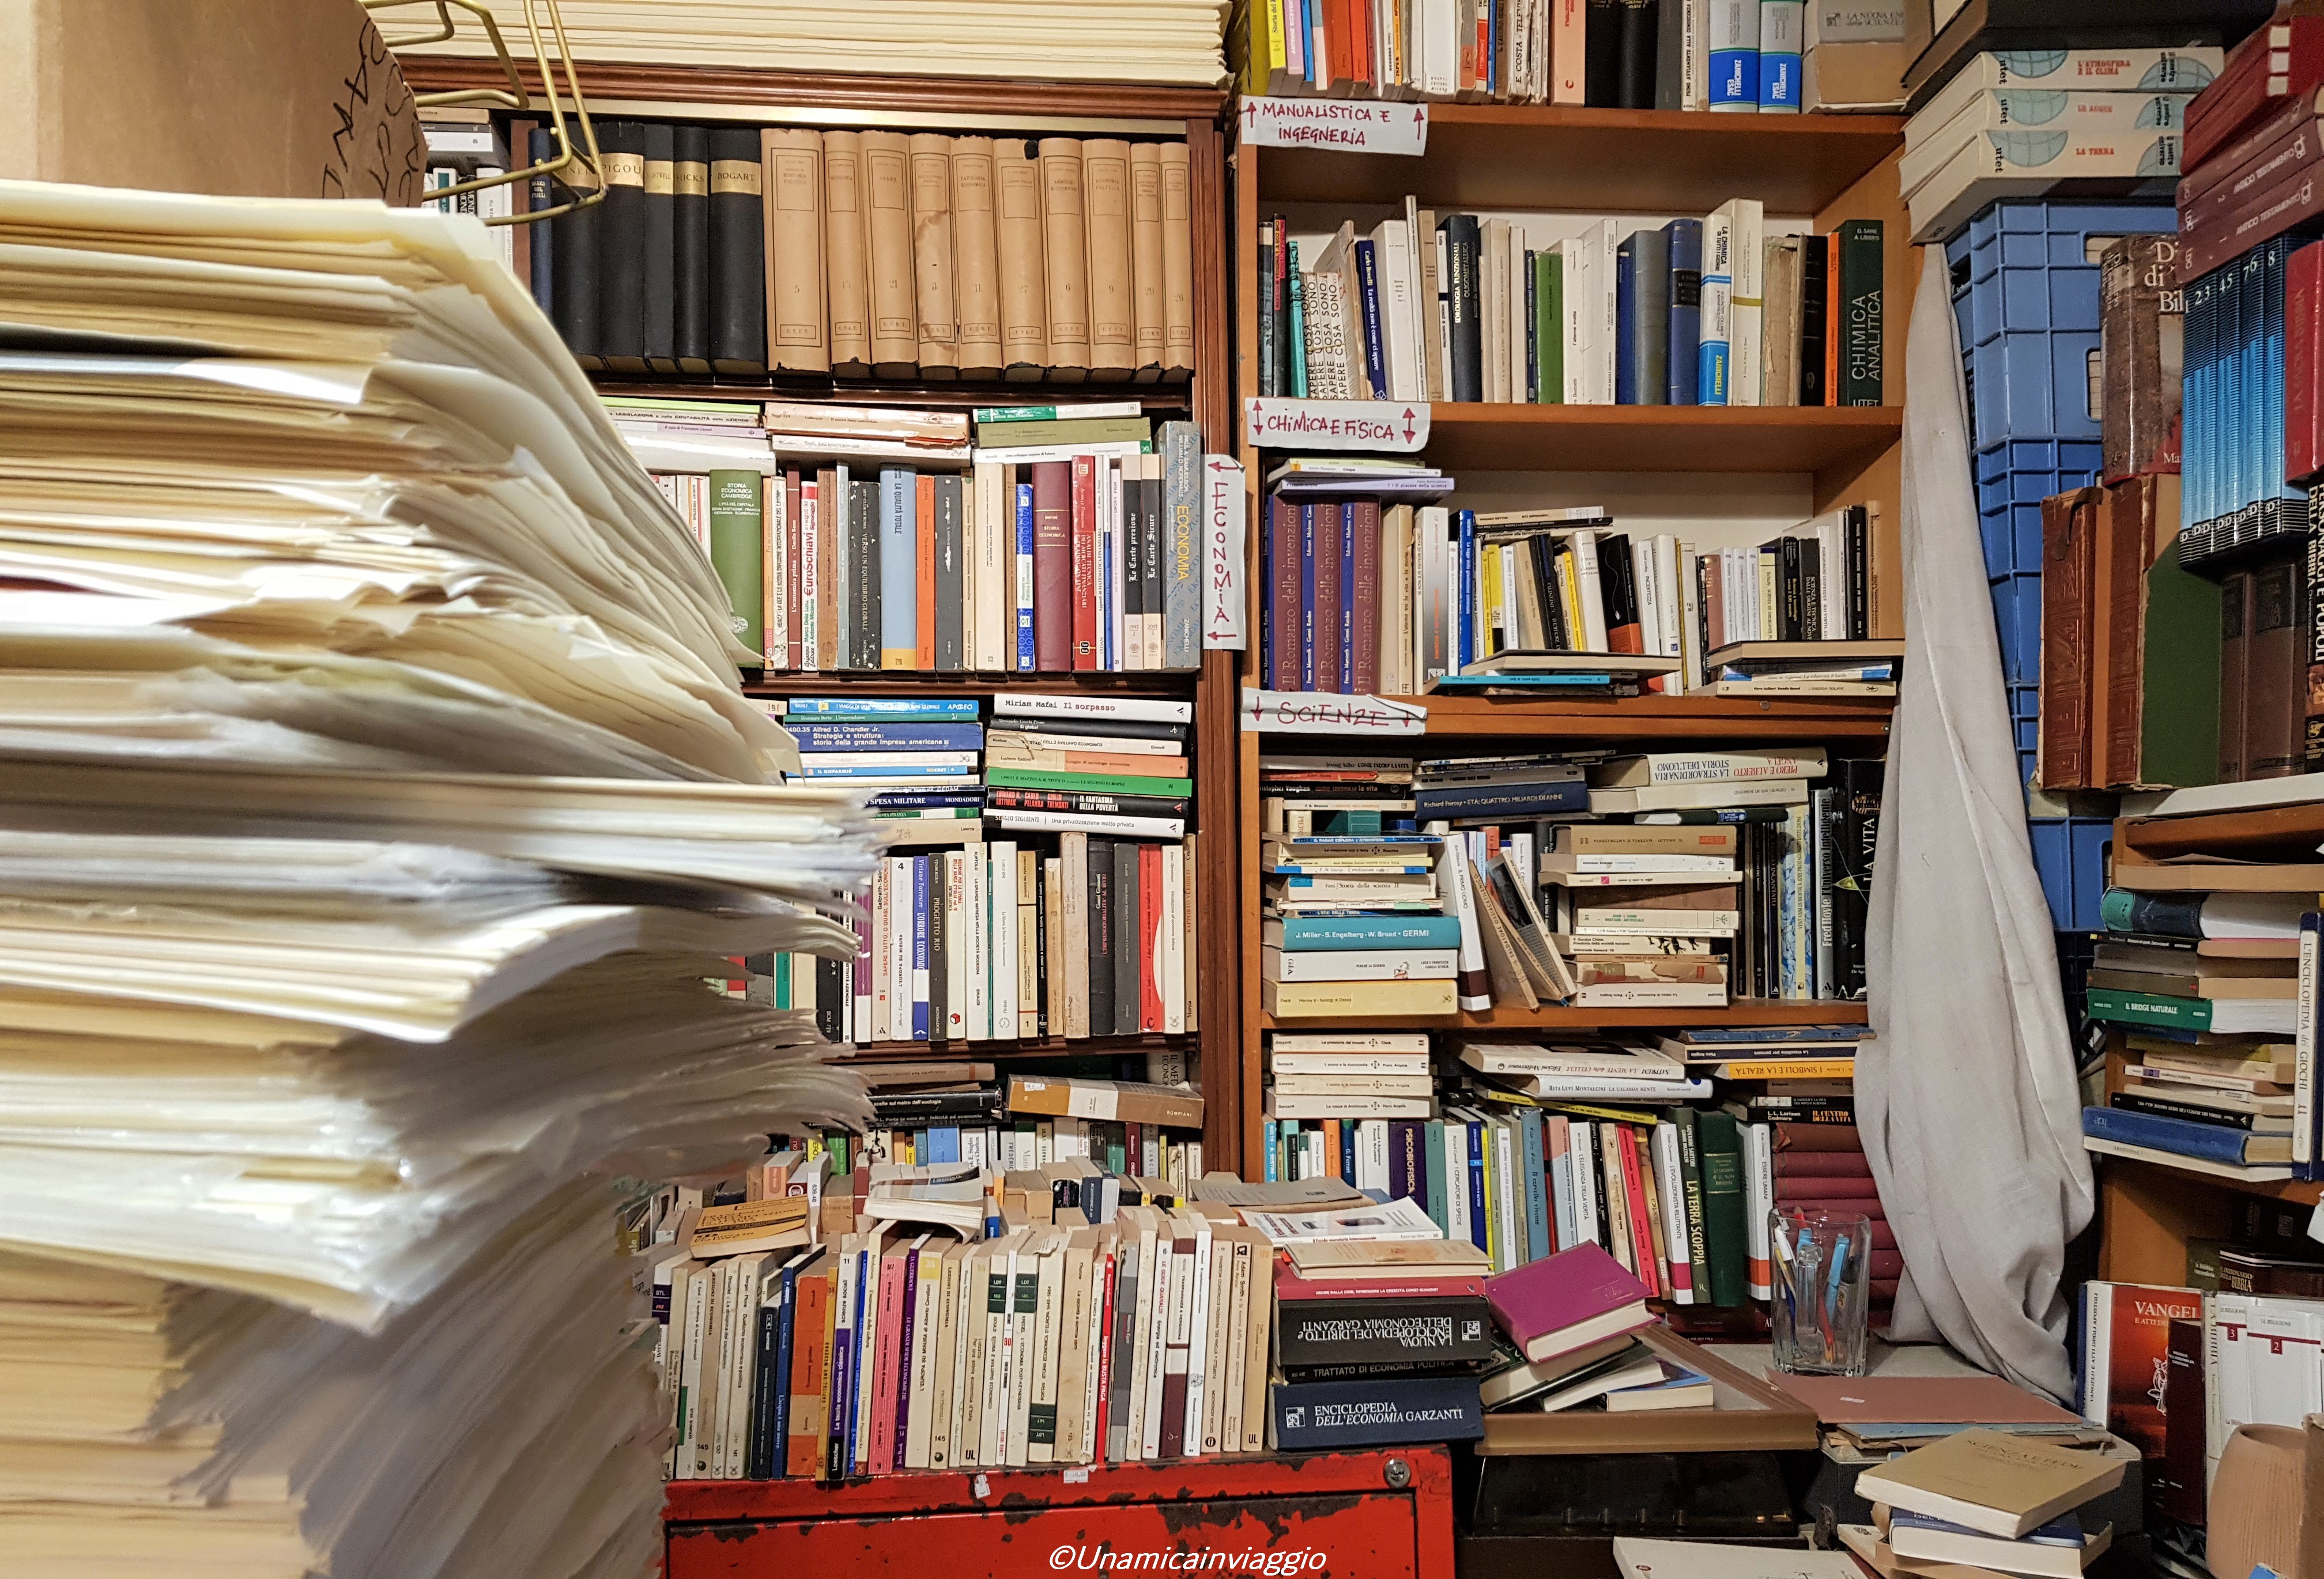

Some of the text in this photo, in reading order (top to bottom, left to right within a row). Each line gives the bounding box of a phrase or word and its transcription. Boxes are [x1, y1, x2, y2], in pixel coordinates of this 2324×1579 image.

[1998, 59, 2006, 85] utet
[1263, 103, 1391, 122] MANUALISTICA E
[1278, 122, 1365, 145] INGEGNERIA
[1995, 146, 2004, 173] utet
[676, 174, 704, 183] HICKS
[718, 172, 754, 182] BOGART
[1722, 226, 1727, 235] LA
[1852, 296, 1866, 380] CHIMICA
[1868, 290, 1881, 381] ANALITICA
[1268, 411, 1394, 441] CHIMICA E FISICA
[894, 491, 903, 512] QUALITÀ
[1177, 505, 1190, 580] ECONOMIA
[2307, 486, 2318, 588] DELLA BIBBIA
[862, 553, 867, 562] UN
[1212, 482, 1231, 624] ECONOMIA
[1282, 504, 1296, 685] Il Romanzo delle invenzioni
[1320, 504, 1334, 685] Il Romanzo delle invenzioni
[1358, 504, 1372, 685] Il Romanzo delle invenzioni
[1277, 701, 1390, 727] SCIENZE
[1657, 760, 1729, 771] STORIA DELL'UOMO
[1734, 765, 1798, 776] PIERO E ALBERTO
[1655, 770, 1718, 781] STRAORDINARIA
[1080, 802, 1118, 812] DELLA POVERTÀ
[2131, 1003, 2149, 1013] BRIDGE
[2151, 1004, 2178, 1015] NATURALE
[1736, 1067, 1764, 1076] REALTÀ
[1405, 1128, 1416, 1194] PSICOBIOFISICA
[1687, 1181, 1705, 1265] LA TERRA SCOPPIA
[2231, 1276, 2253, 1292] BIBBIA
[1303, 1317, 1451, 1331] DELL'ECONOMIA GARZANTI
[1298, 1327, 1452, 1340] ENCICLOPEDIA DEL DIRITTO e
[2229, 1329, 2235, 1338] 3
[1400, 1337, 1452, 1347] LA NUOVA
[2274, 1342, 2280, 1351] 2
[1314, 1402, 1396, 1416] ENCICLOPEDIA
[1315, 1409, 1463, 1427] DELL'ECONOMIA GARZANTI
[834, 1422, 840, 1430] La
[1248, 1434, 1258, 1444] UL
[966, 1449, 976, 1460] UL
